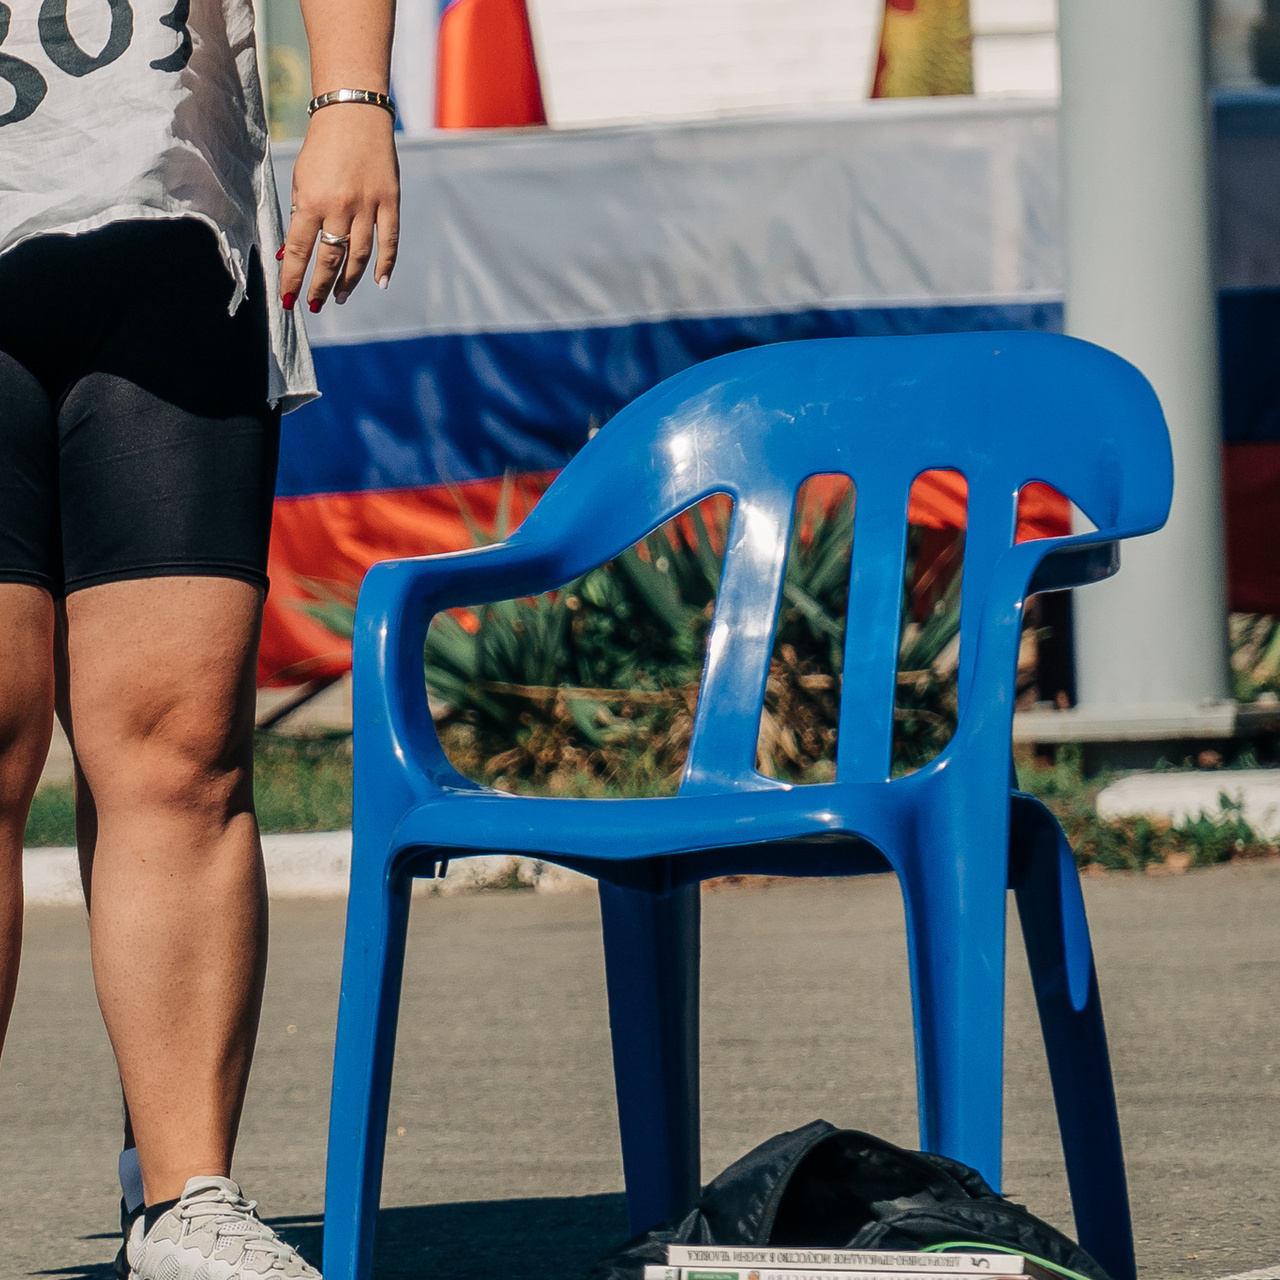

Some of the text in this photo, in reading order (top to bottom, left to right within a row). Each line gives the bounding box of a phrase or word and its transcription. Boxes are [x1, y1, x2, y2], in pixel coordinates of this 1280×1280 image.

[687, 1250, 730, 1262] ЧЕЛОВЕКА
[733, 1251, 768, 1262] ЖИЗНИ
[769, 1252, 775, 1262] В
[778, 1252, 831, 1264] ИСКУССТВО
